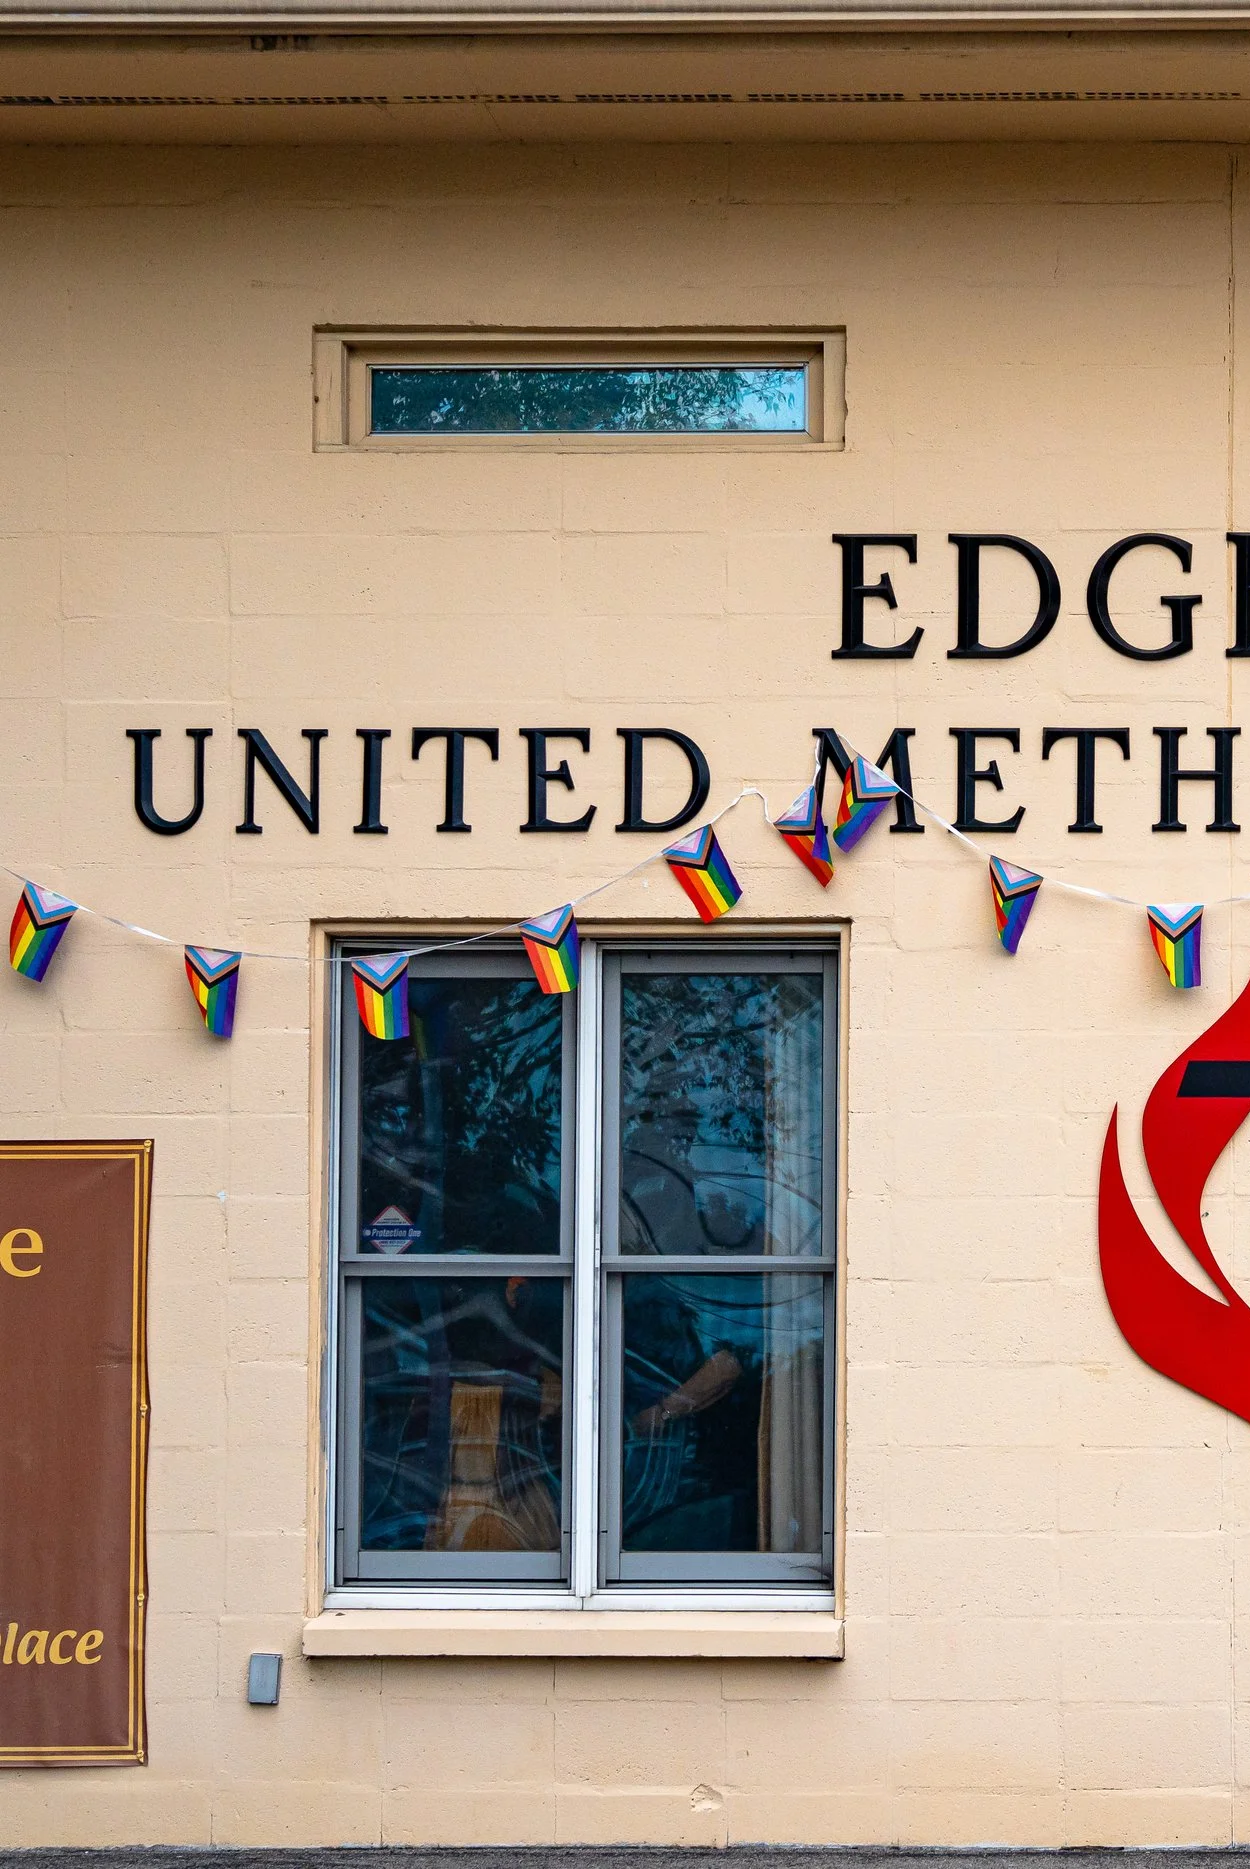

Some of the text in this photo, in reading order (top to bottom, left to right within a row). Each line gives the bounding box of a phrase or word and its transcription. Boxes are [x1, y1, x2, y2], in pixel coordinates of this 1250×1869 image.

[125, 727, 711, 837] UNITED
[371, 1228, 422, 1238] Protection One
[0, 1622, 104, 1665] lace
